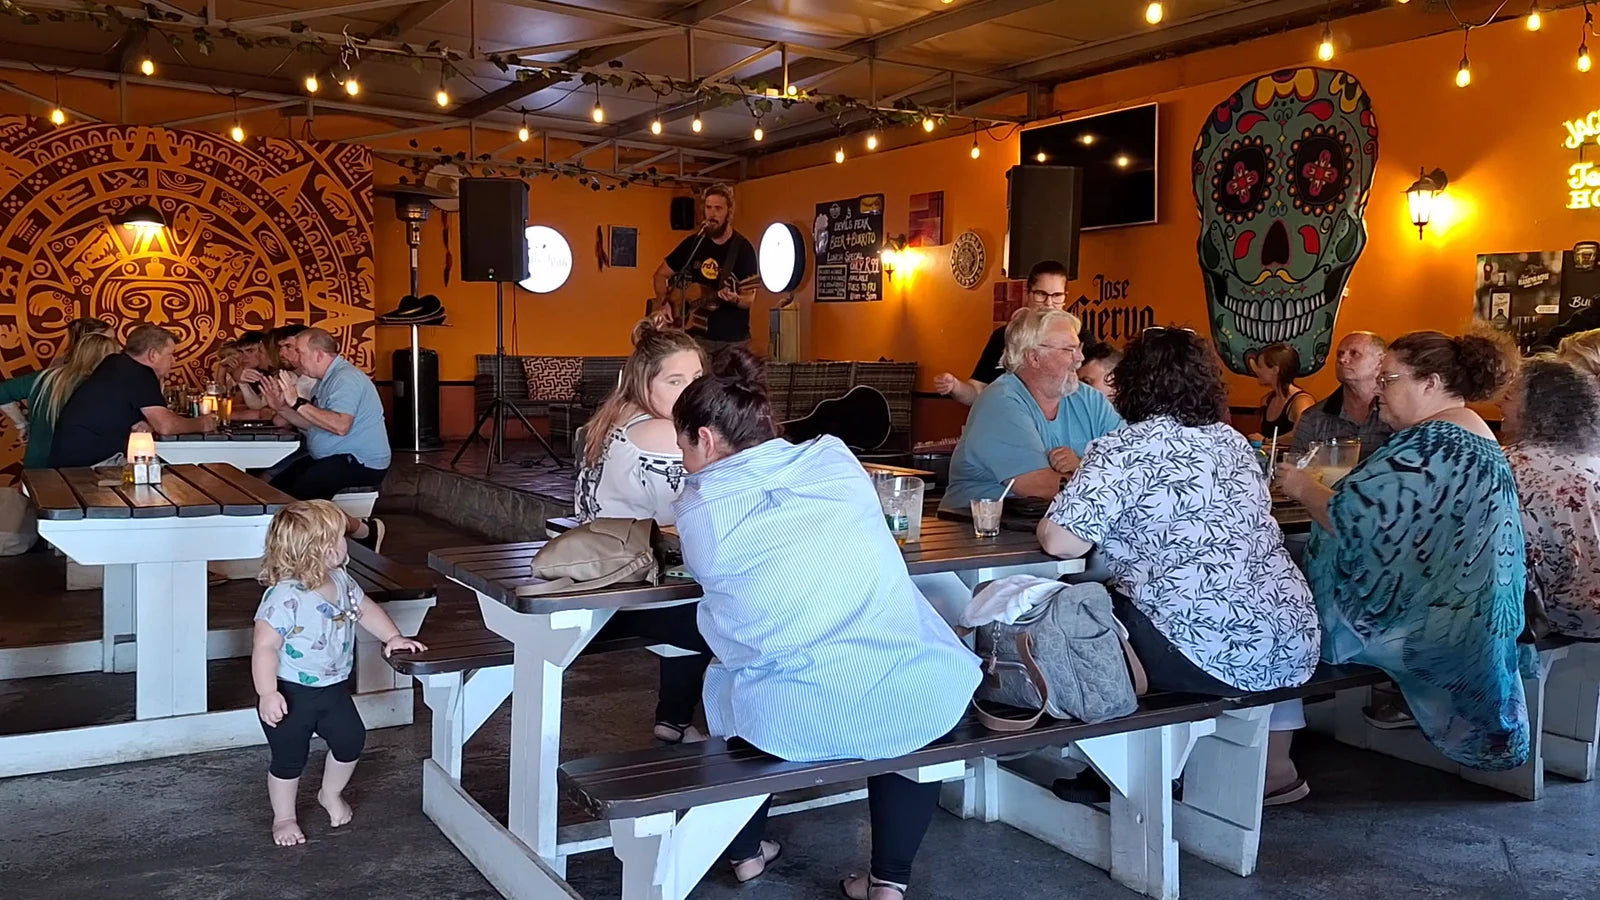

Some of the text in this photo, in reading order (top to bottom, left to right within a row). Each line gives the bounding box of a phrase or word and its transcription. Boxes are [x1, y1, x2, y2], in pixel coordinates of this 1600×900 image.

[854, 218, 872, 231] PEAK
[830, 235, 847, 250] BEER
[851, 232, 875, 247] BURRITO
[1093, 274, 1130, 306] Jose
